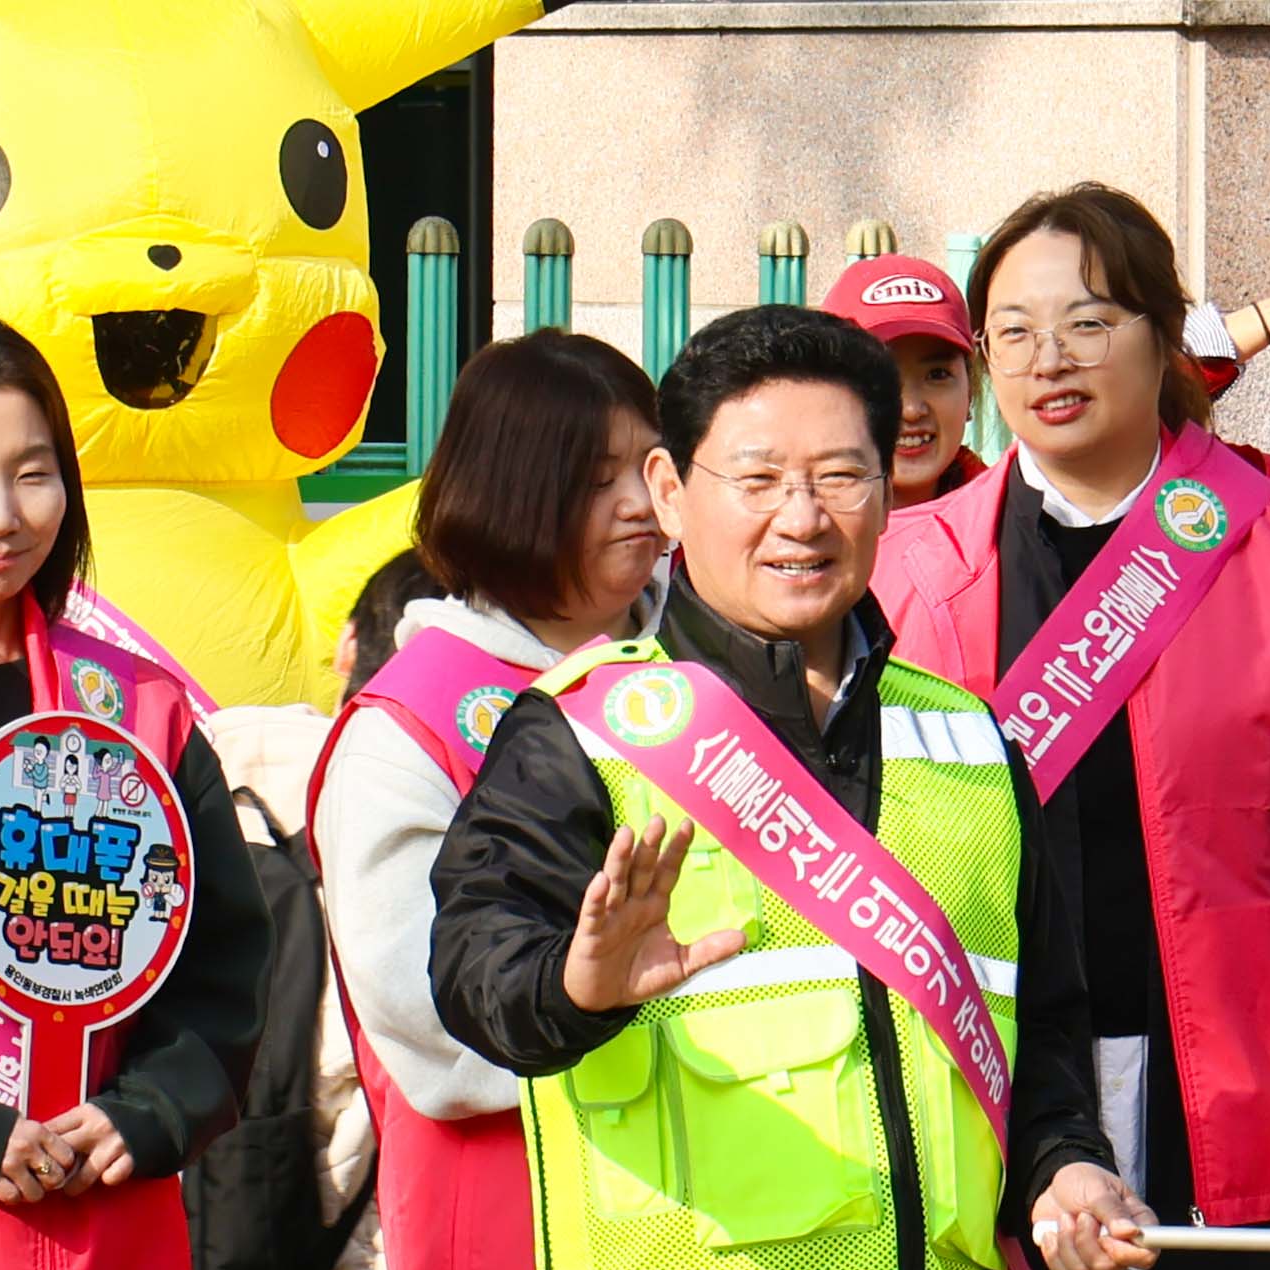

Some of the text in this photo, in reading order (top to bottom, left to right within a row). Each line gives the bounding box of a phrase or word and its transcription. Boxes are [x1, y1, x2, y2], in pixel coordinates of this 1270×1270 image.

[870, 281, 935, 302] emis
[1041, 544, 1181, 708] 스쿨존에서는
[62, 876, 136, 926] 때는
[687, 727, 1006, 1105] 스쿨존에서는 어린이가 주인공
